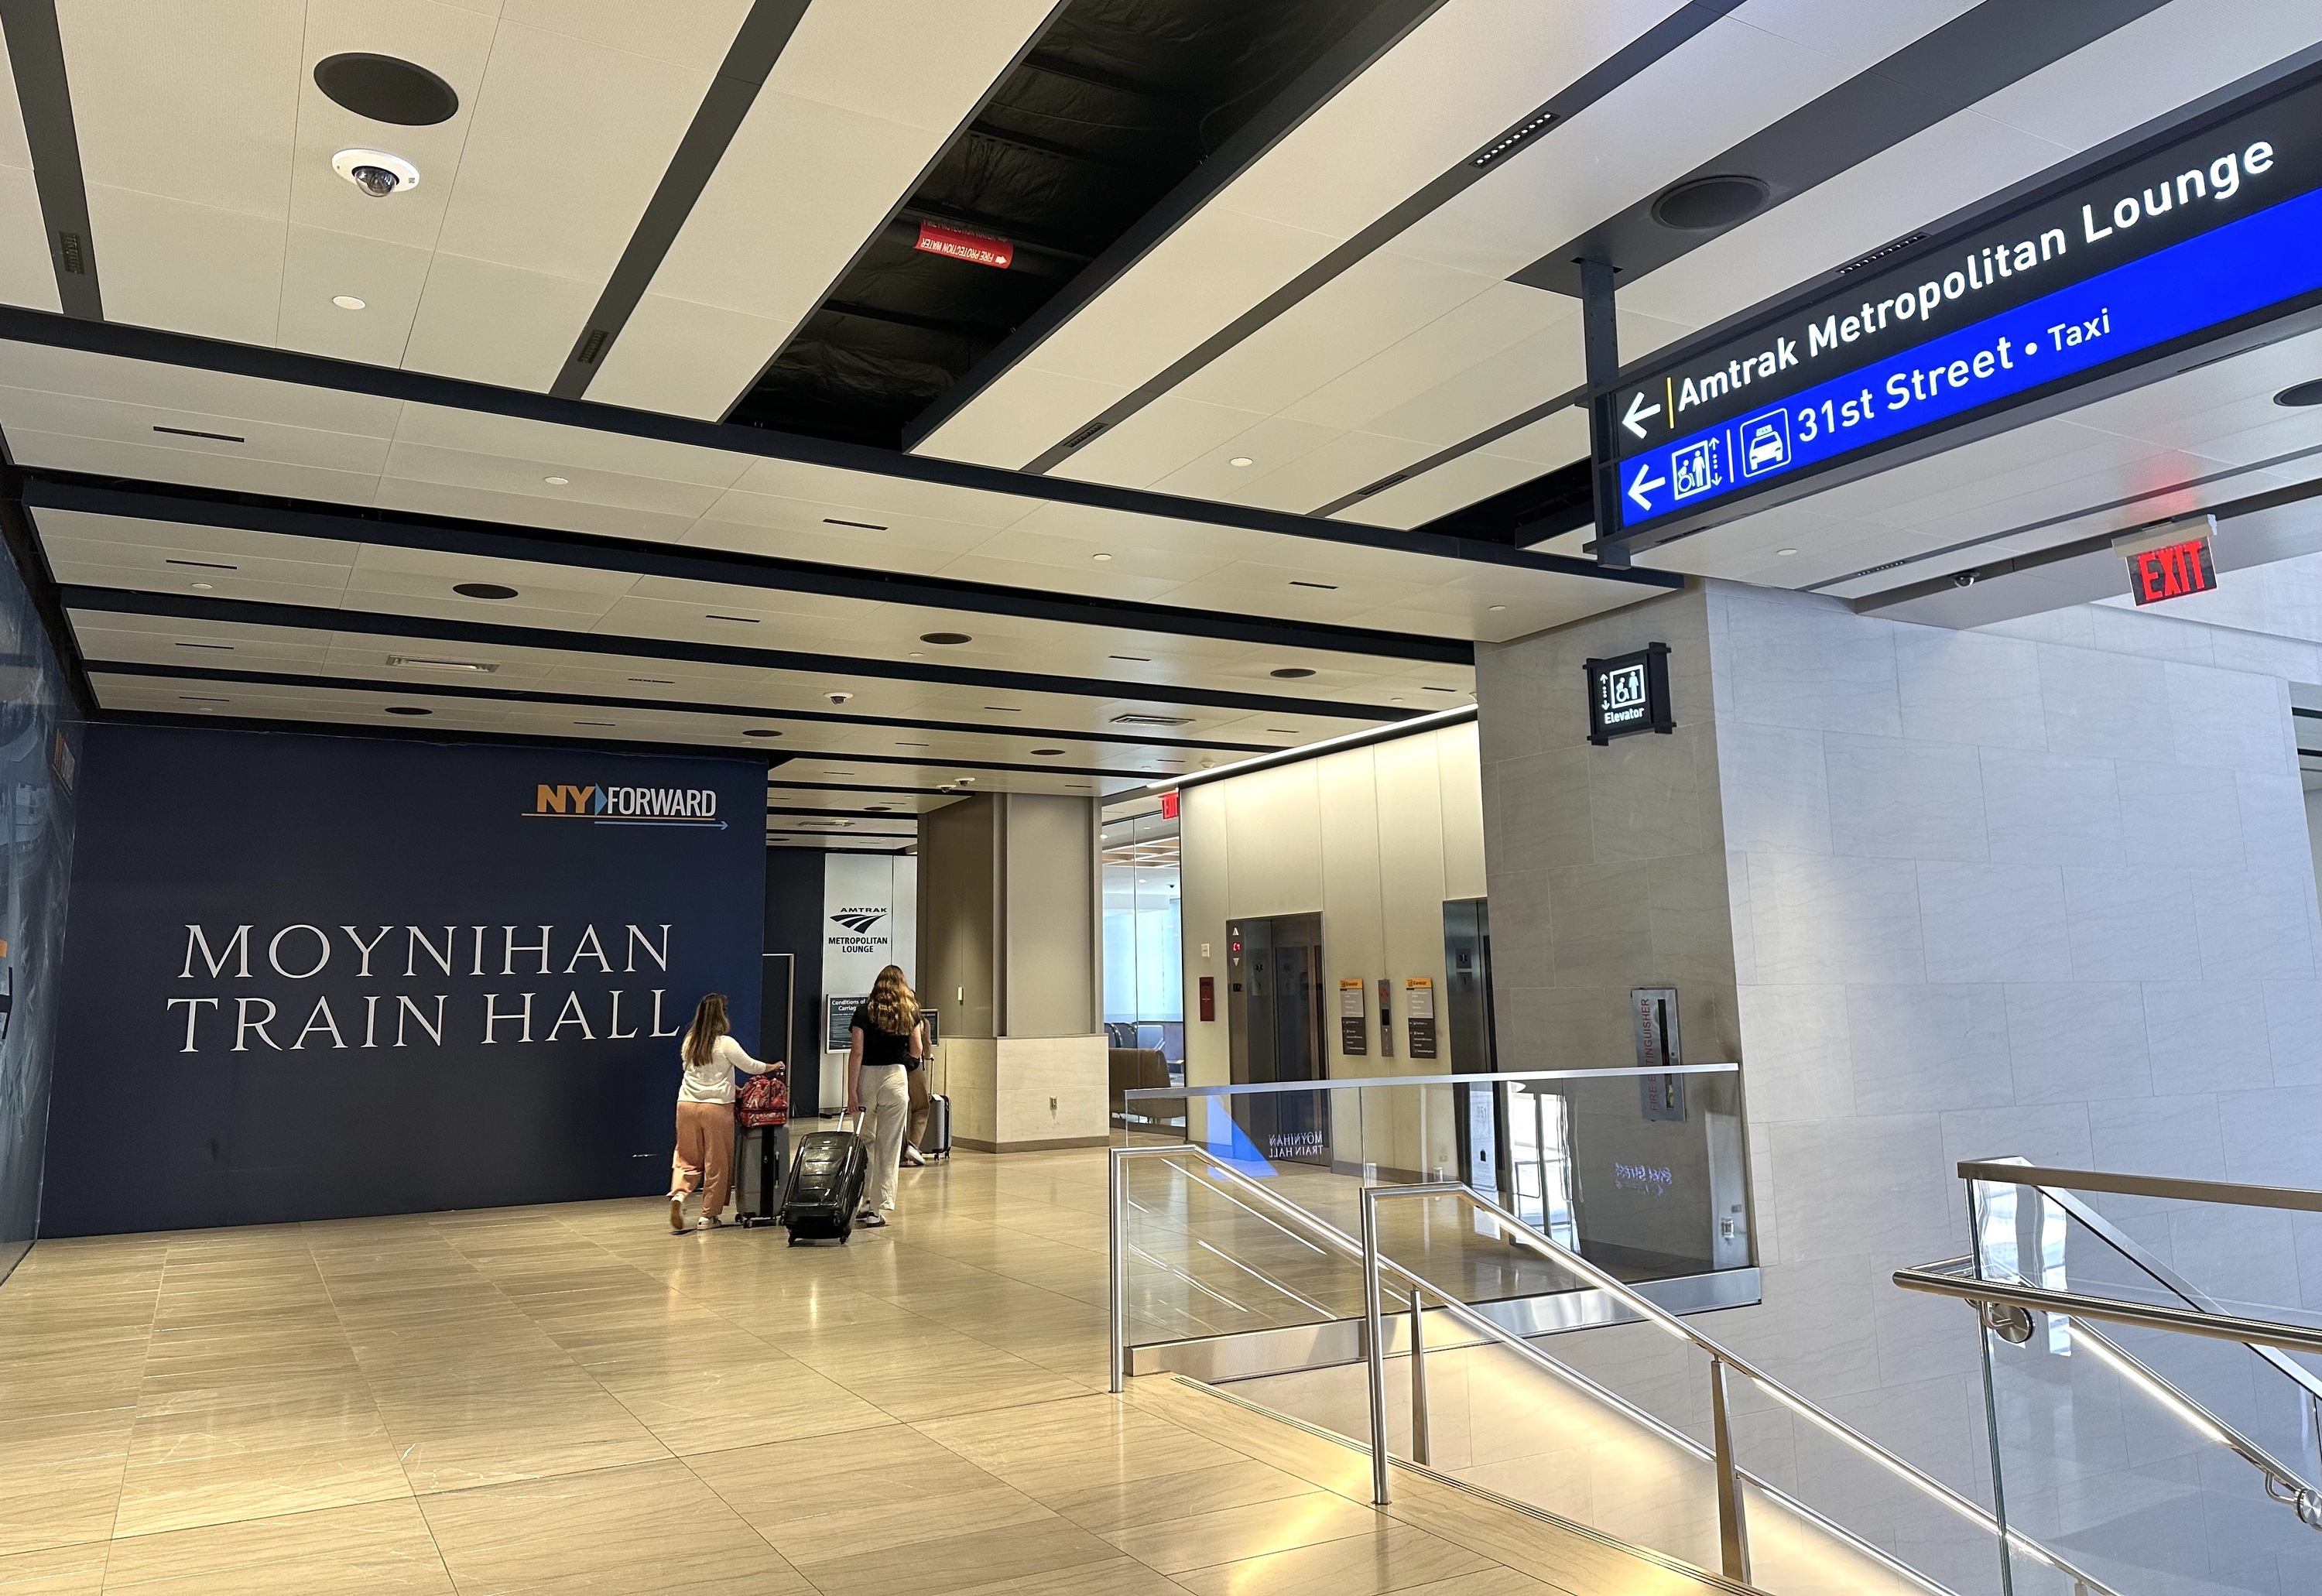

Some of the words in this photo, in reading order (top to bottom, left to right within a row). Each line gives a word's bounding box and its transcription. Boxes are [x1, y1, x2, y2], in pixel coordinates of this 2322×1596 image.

[920, 238, 943, 252] WATER
[941, 242, 981, 259] PROTECTION
[979, 251, 995, 262] FIRE
[1677, 337, 1799, 413] Amtrak
[1807, 226, 2067, 358] Metropolitan
[2082, 140, 2276, 244] Lounge
[1796, 387, 1876, 443] 31st
[1885, 336, 2014, 411] Street
[2046, 308, 2112, 353] Taxi
[2138, 539, 2205, 601] EXIT
[1604, 707, 1645, 724] Elevator
[536, 784, 596, 813] NY
[607, 786, 717, 817] FORWARD
[177, 923, 673, 979] MOYNIHAN
[828, 937, 888, 945] METROPOLITAN
[842, 945, 874, 954] LOUNGE
[166, 995, 448, 1053] TRAIN
[481, 988, 681, 1044] HALL
[1640, 998, 1657, 1081] ETINGUISHER
[1649, 1084, 1659, 1111] FIRE
